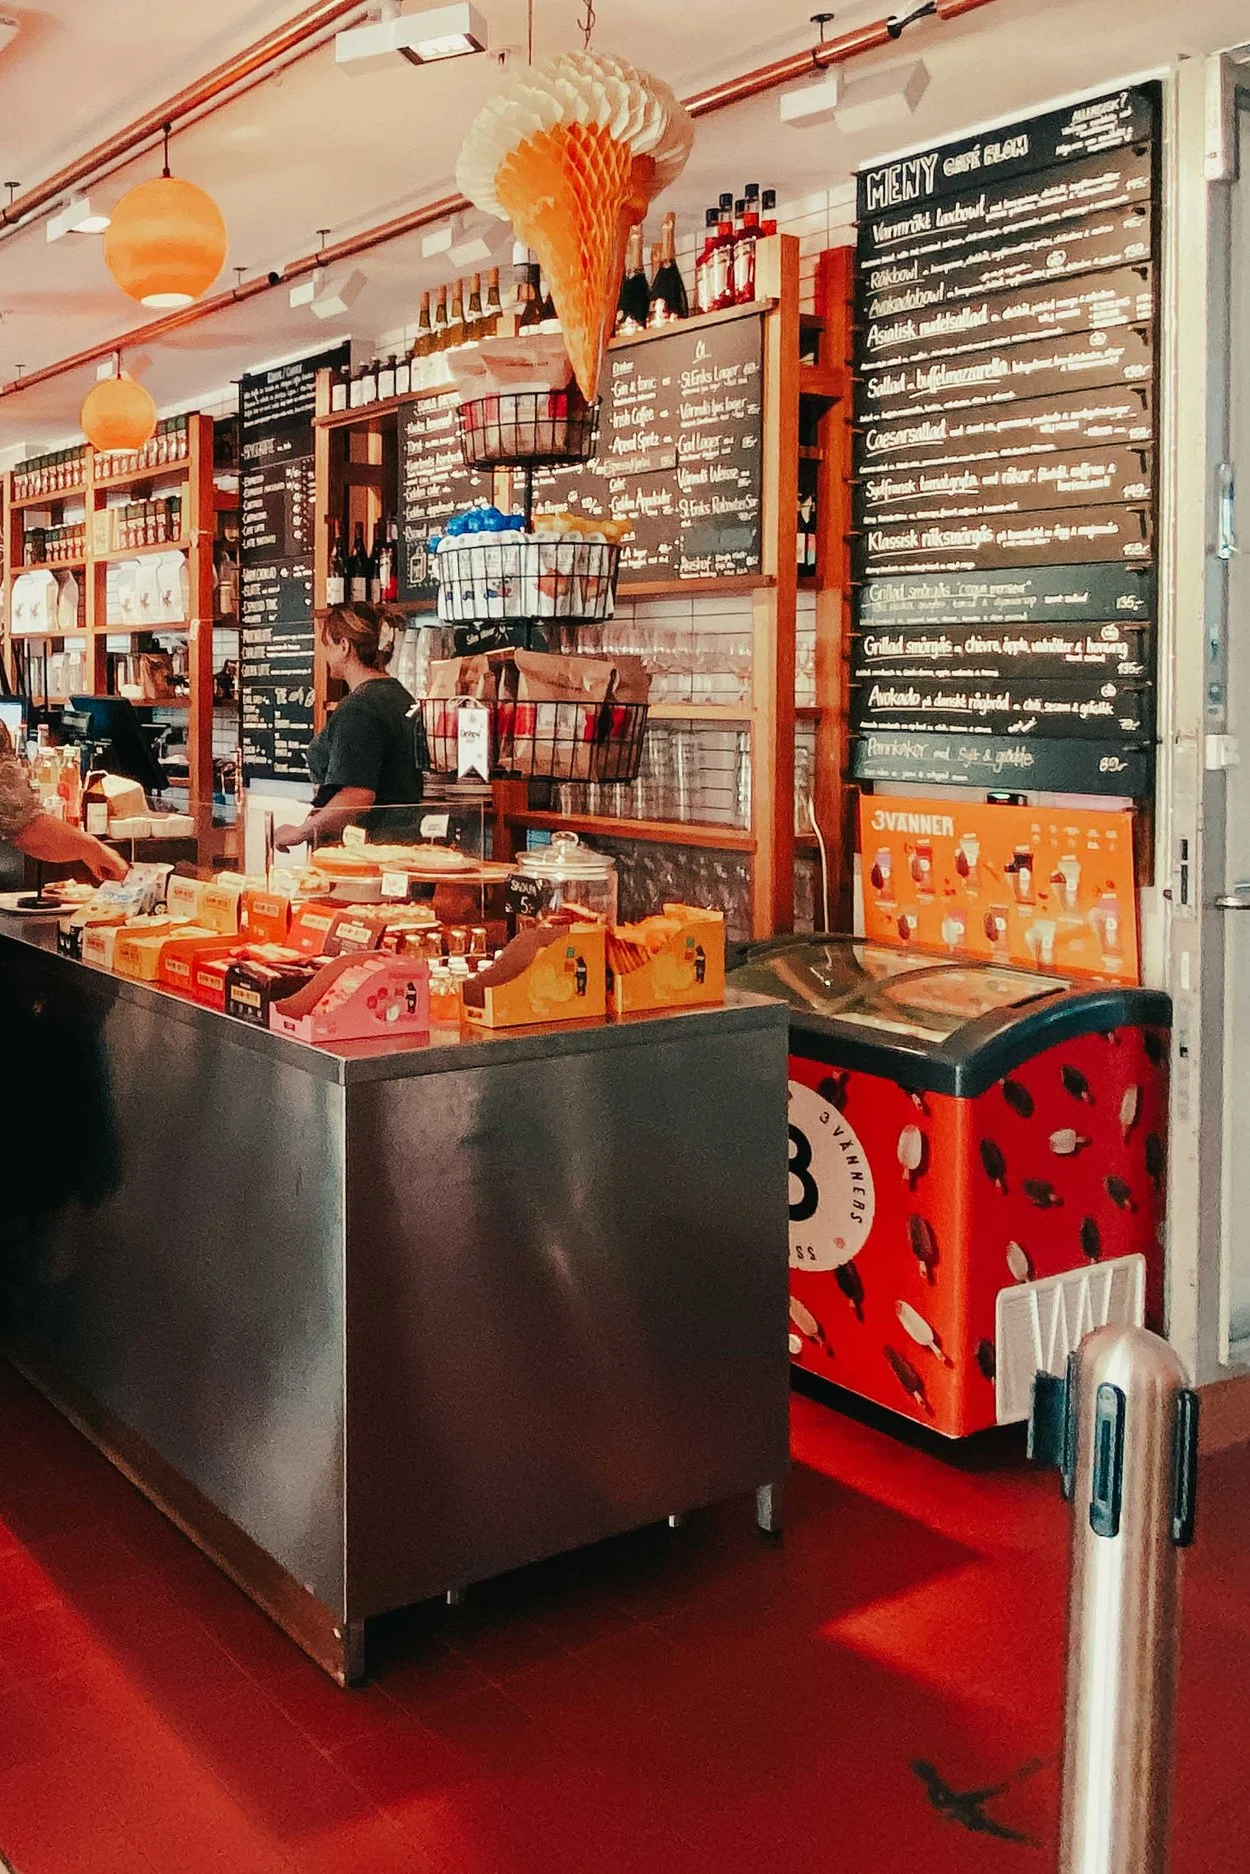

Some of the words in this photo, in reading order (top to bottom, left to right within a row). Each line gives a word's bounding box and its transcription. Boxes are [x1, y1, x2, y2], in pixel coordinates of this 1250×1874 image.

[866, 153, 939, 211] MENY
[867, 528, 918, 552] Klassisk
[863, 634, 904, 656] Grillad
[867, 684, 921, 707] Avokado
[870, 809, 955, 838] 3VÄNNER
